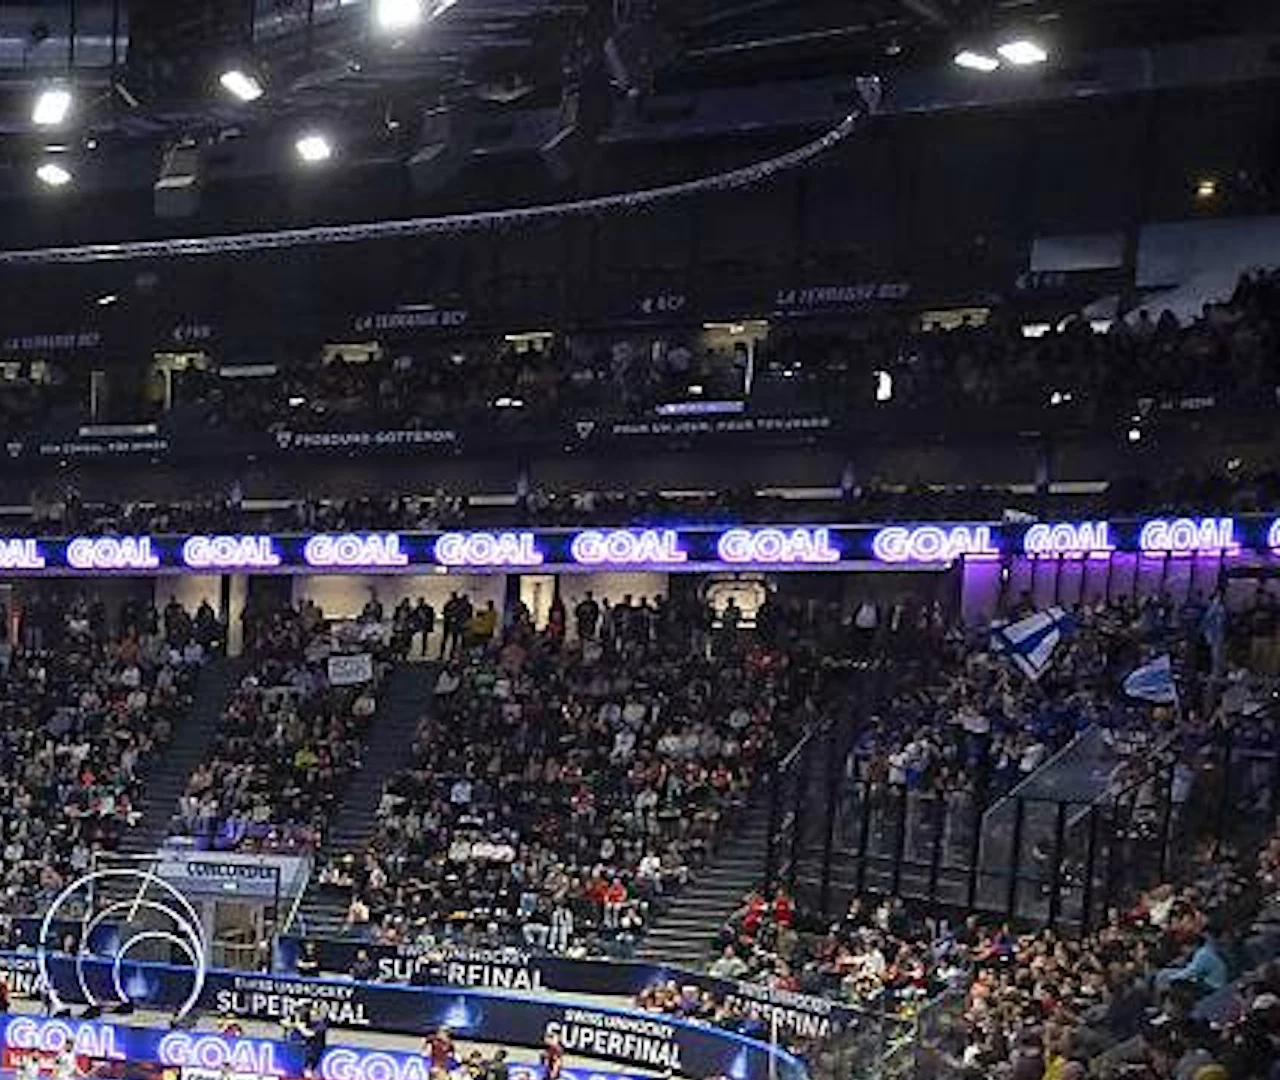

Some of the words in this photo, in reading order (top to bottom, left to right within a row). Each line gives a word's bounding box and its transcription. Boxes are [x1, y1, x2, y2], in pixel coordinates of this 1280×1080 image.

[67, 536, 159, 568] GOAL
[182, 535, 280, 567] GOAL
[304, 534, 409, 566] GOAL
[435, 532, 544, 567] GOAL
[571, 529, 688, 565] GOAL
[718, 526, 840, 563] GOAL
[872, 526, 1001, 563] GOAL
[1023, 520, 1116, 560] GOAL
[1141, 518, 1242, 558] GOAL
[378, 958, 548, 992] SURFINAL
[4, 1018, 127, 1065] GOAL
[157, 1031, 288, 1080] GOAL
